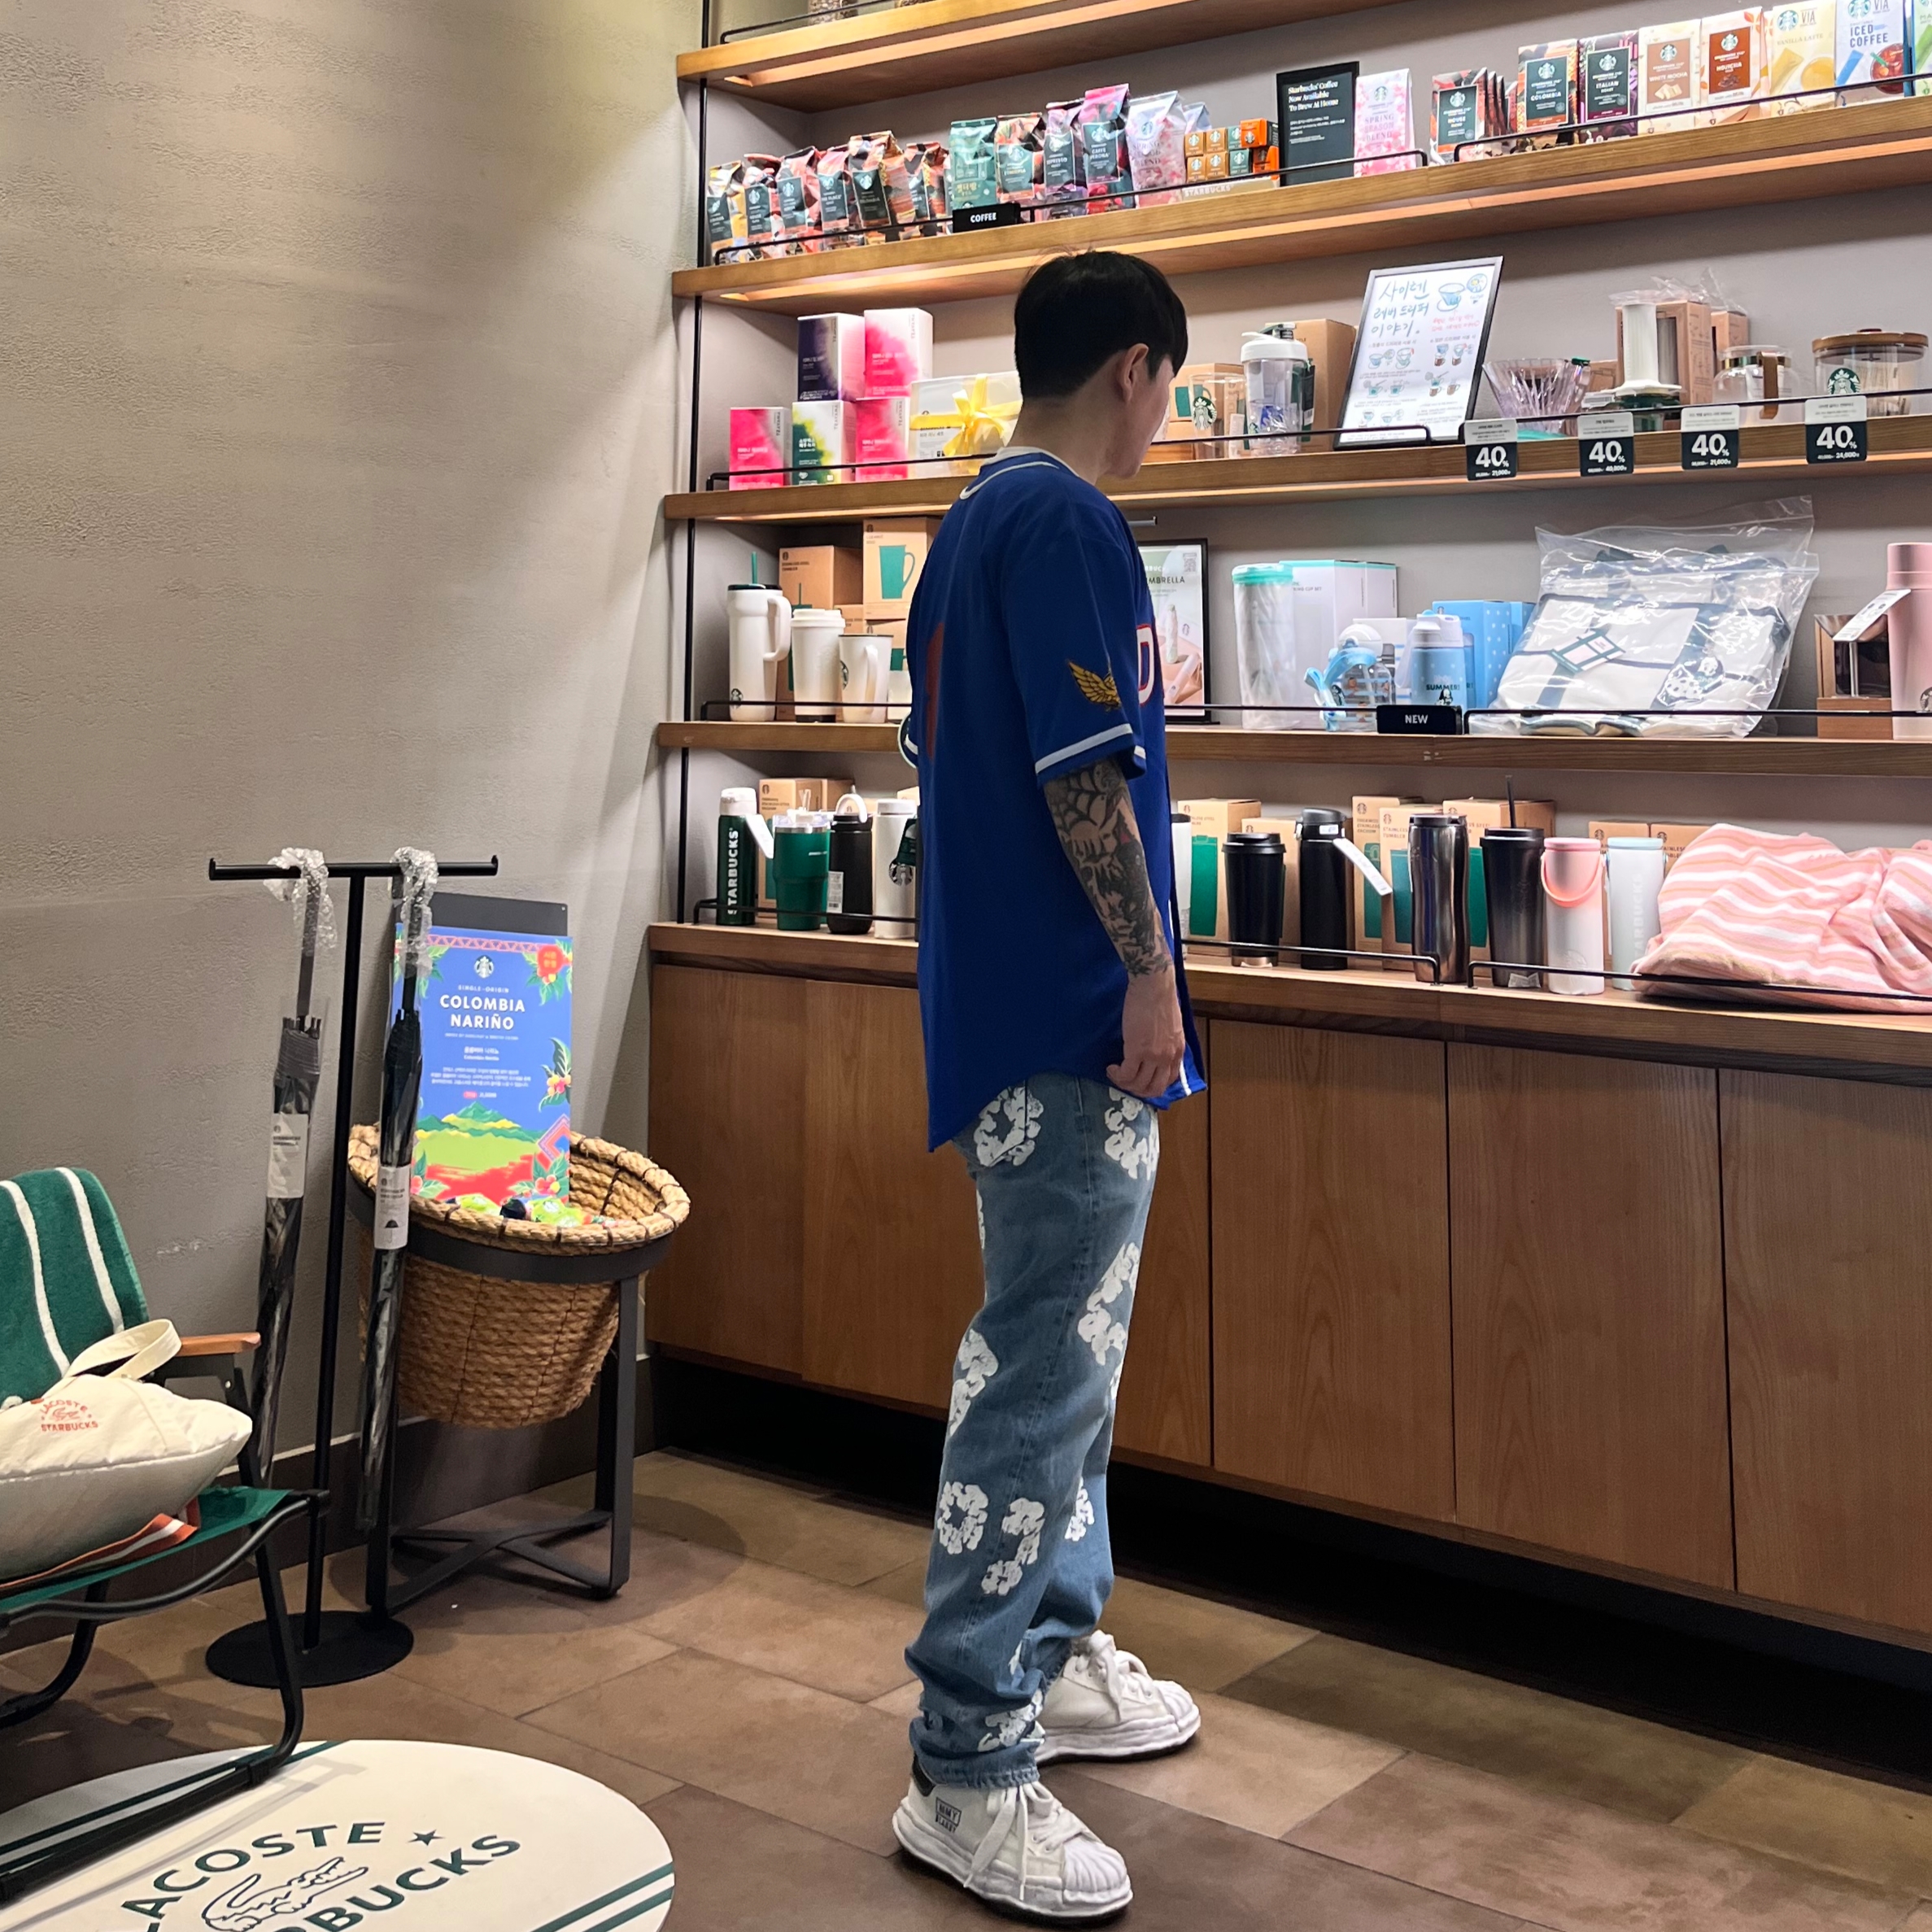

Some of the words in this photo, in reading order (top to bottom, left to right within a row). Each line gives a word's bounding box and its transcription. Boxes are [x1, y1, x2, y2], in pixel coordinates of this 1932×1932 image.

[1801, 10, 1816, 24] VIA
[1850, 24, 1873, 37] ICED
[1777, 37, 1803, 46] VANILLA
[1803, 33, 1824, 41] LATTE
[1850, 33, 1889, 47] COFFEE
[1649, 74, 1666, 82] WHITE
[1667, 72, 1688, 81] MOCHA
[1319, 80, 1338, 89] Coffee
[1289, 95, 1302, 103] Now
[1302, 91, 1330, 102] Available
[1530, 91, 1562, 102] COLOMBIA
[1289, 104, 1297, 112] To
[1365, 113, 1394, 123] SPRING
[1366, 130, 1393, 142] BLEND
[1184, 185, 1231, 197] STARBUCKS
[970, 212, 997, 224] COFFEE
[1378, 279, 1430, 302] 사이렌
[1399, 302, 1430, 318] 드리퍼
[1816, 425, 1858, 449] 40%
[1691, 433, 1730, 456] 40%
[1475, 445, 1510, 468] 40%
[1589, 440, 1626, 464] 40%
[1149, 575, 1185, 584] MBRELLA
[1405, 713, 1428, 724] NEW
[727, 830, 739, 915] STARBUCKS
[440, 994, 526, 1013] COLOMBIA
[450, 1014, 514, 1031] NARIÑO
[41, 1421, 98, 1432] STARBUCKS
